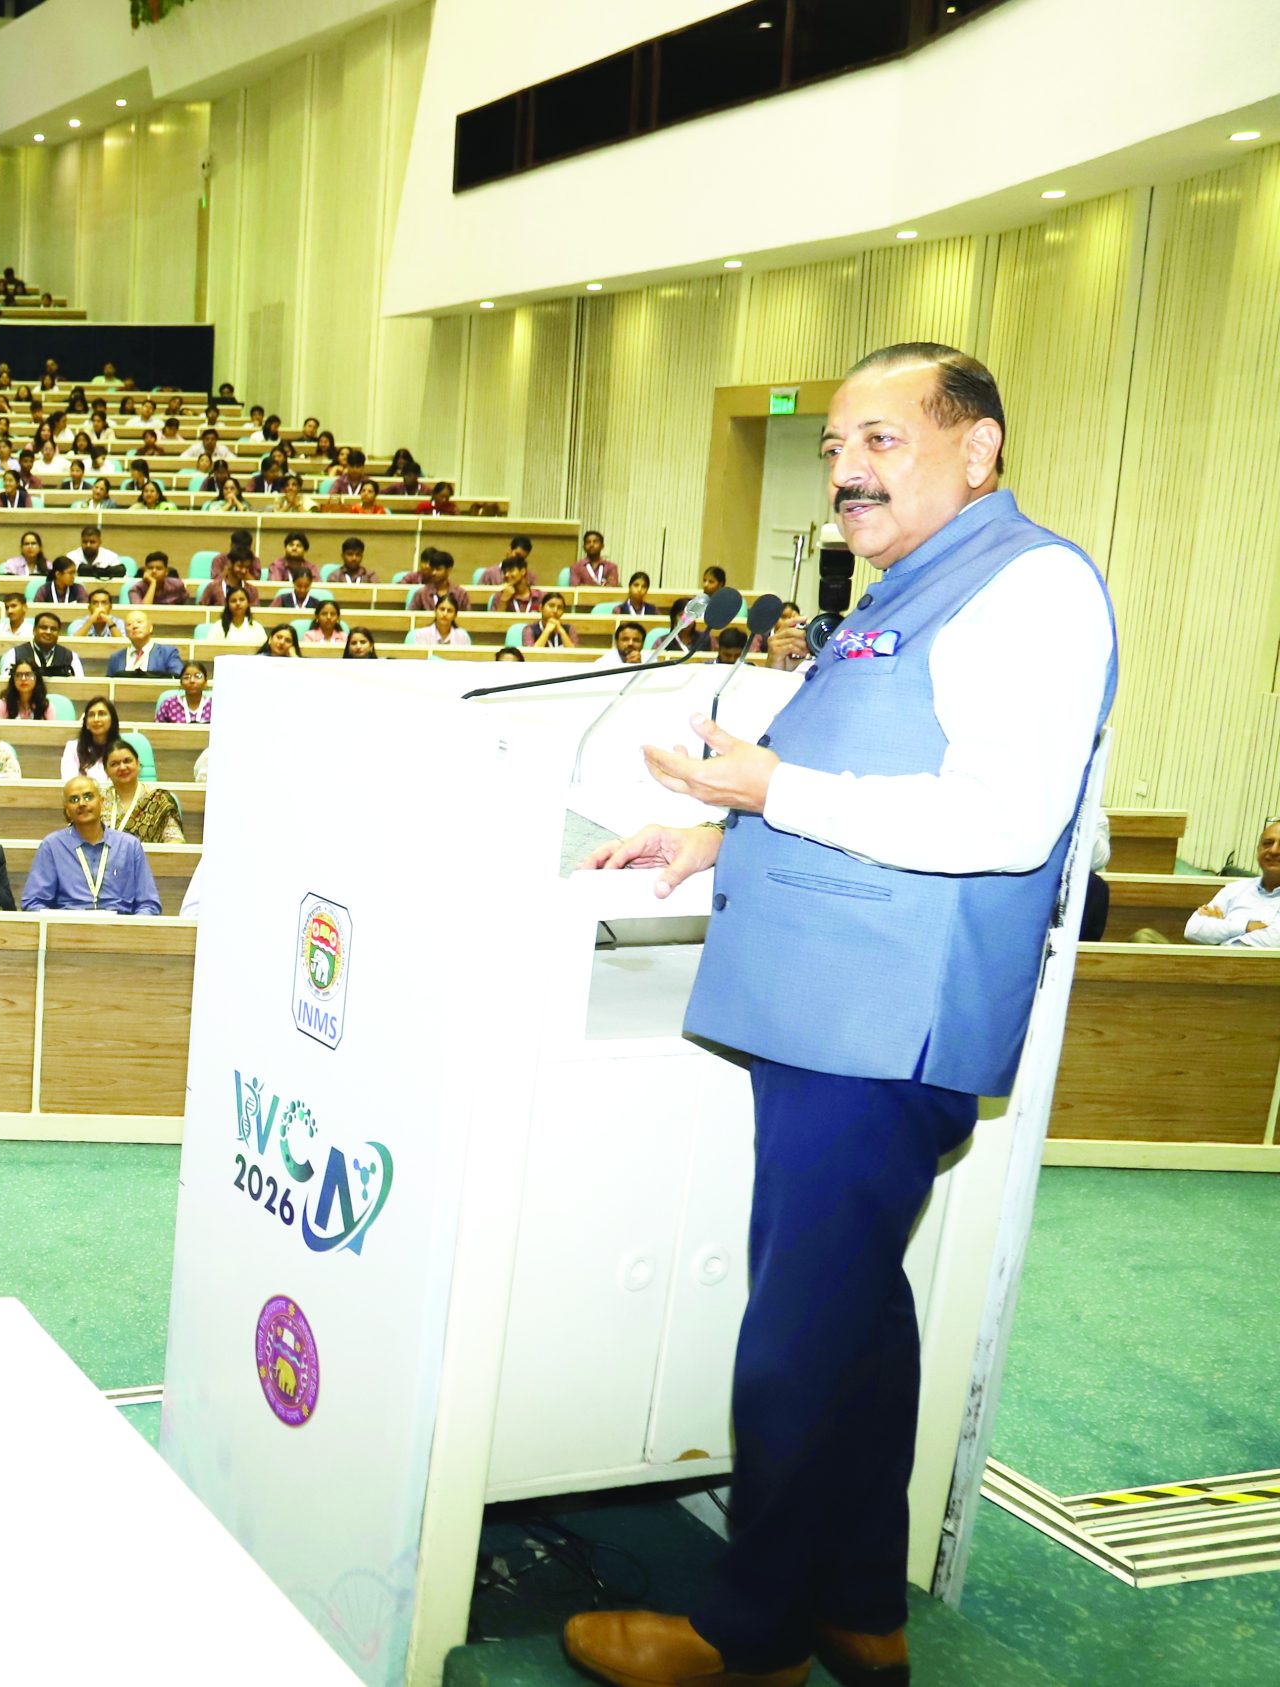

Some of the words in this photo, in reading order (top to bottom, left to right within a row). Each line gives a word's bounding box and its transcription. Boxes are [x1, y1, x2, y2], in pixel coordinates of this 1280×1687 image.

[297, 999, 338, 1041] INMS
[233, 1153, 295, 1226] 2026
[234, 1070, 361, 1256] WCA
